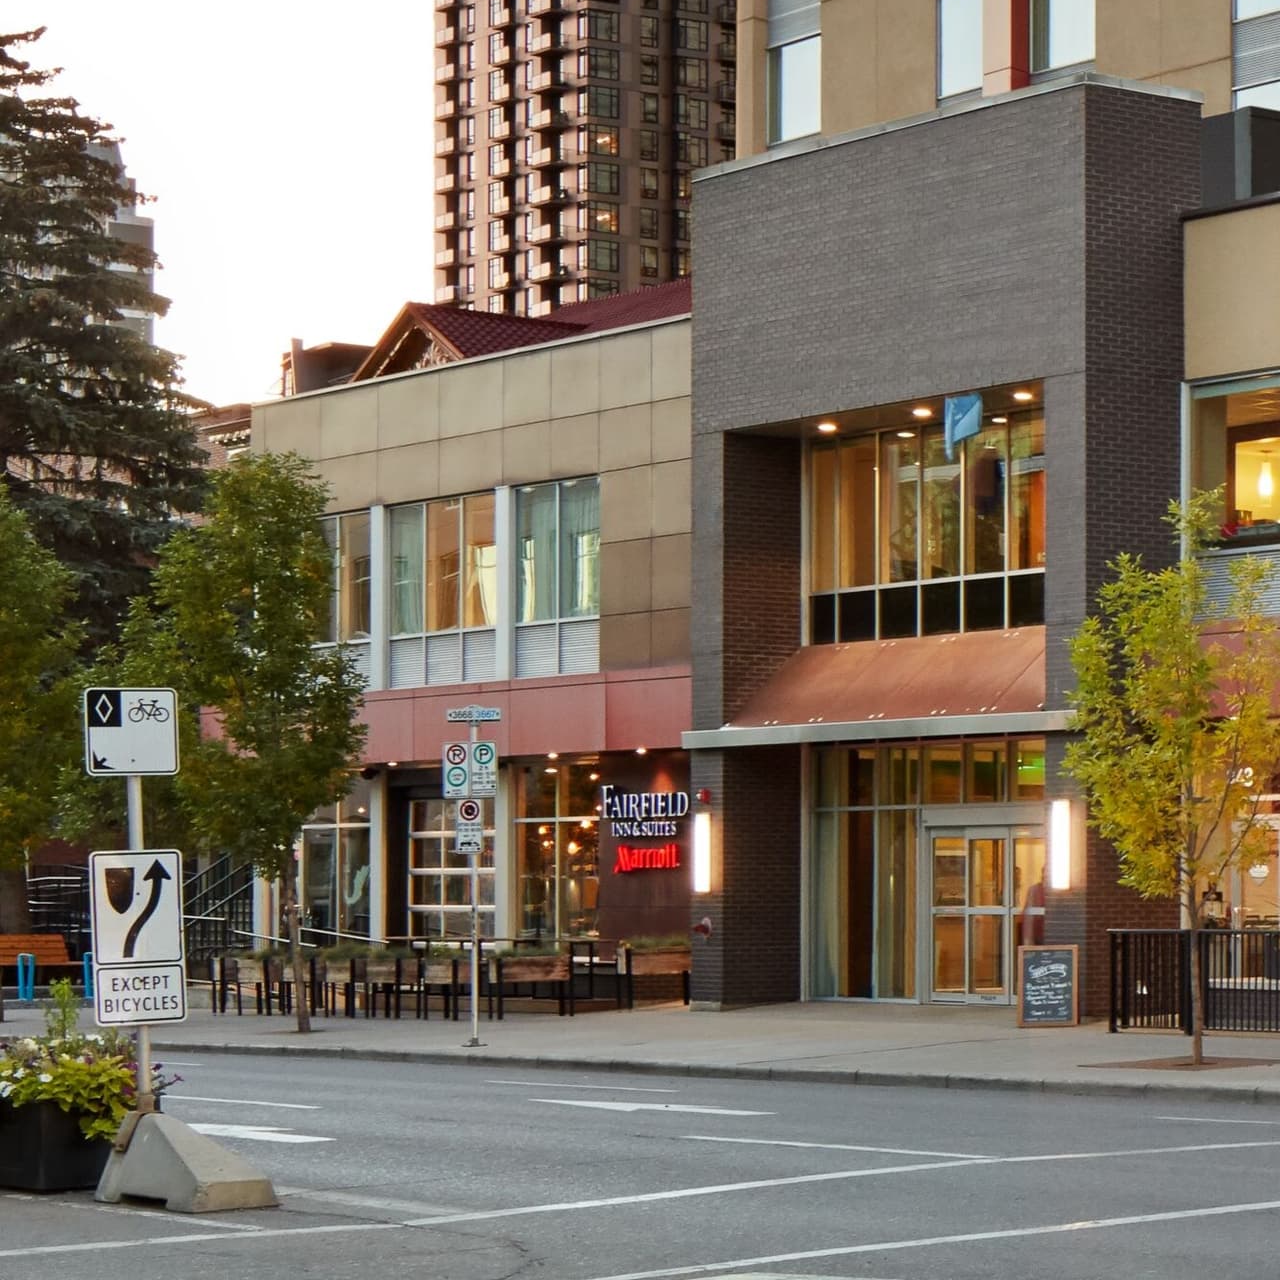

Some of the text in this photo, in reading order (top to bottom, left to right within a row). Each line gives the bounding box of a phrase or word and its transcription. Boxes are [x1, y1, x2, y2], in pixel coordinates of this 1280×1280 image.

[601, 784, 689, 821] FAIRFIELD
[611, 821, 632, 837] INN
[641, 821, 677, 836] SUITES
[613, 844, 680, 874] Marriott
[111, 975, 170, 992] EXCEPT
[104, 995, 178, 1013] BICYCLES
